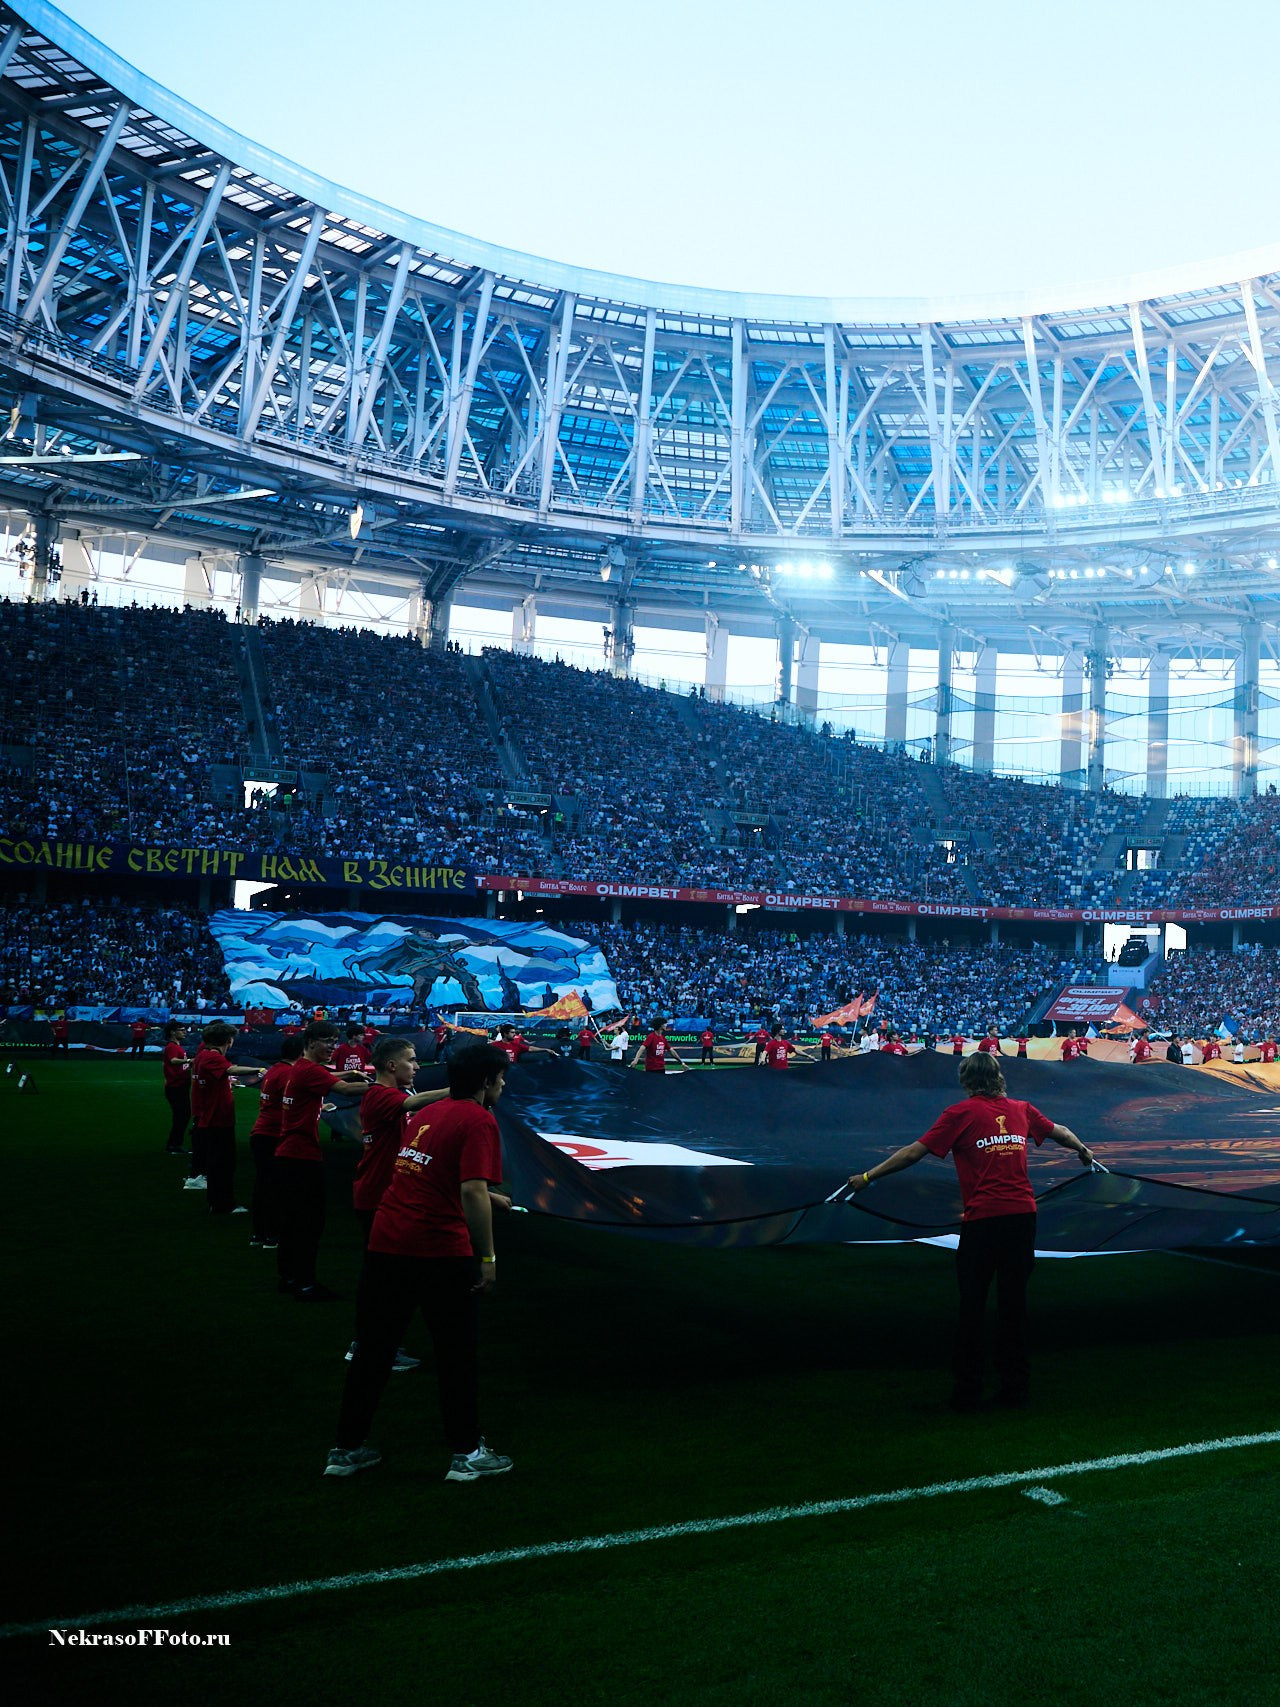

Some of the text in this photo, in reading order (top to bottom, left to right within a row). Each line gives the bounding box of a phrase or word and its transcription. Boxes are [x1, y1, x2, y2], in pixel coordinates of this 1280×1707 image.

[596, 884, 680, 899] OLIMPBET
[765, 895, 840, 908] OLIMPBET
[917, 905, 988, 917] OLIMPBET
[1081, 911, 1152, 920] OLIMPBET
[1220, 908, 1274, 919] OLIMPBET
